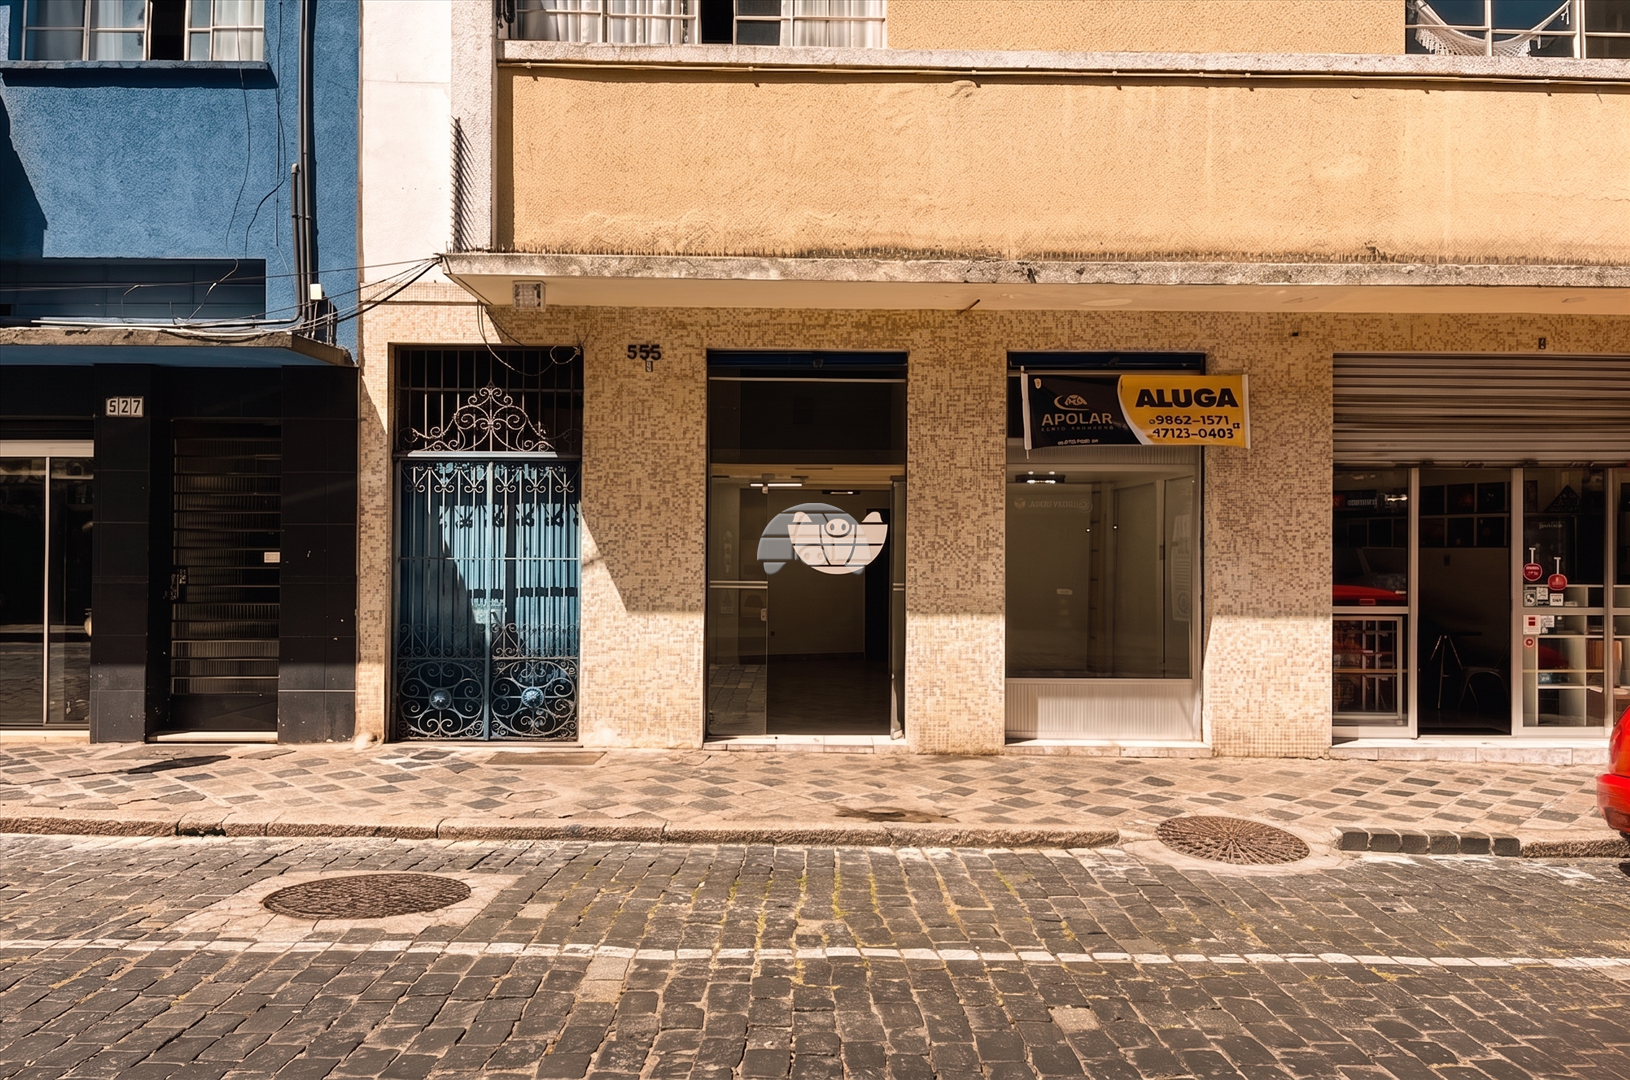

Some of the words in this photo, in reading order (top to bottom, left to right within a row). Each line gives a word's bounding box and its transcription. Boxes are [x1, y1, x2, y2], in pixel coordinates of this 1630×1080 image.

[627, 344, 662, 361] 555
[1135, 388, 1239, 408] ALUGA
[109, 399, 141, 414] 527
[1041, 412, 1113, 427] APOLAR
